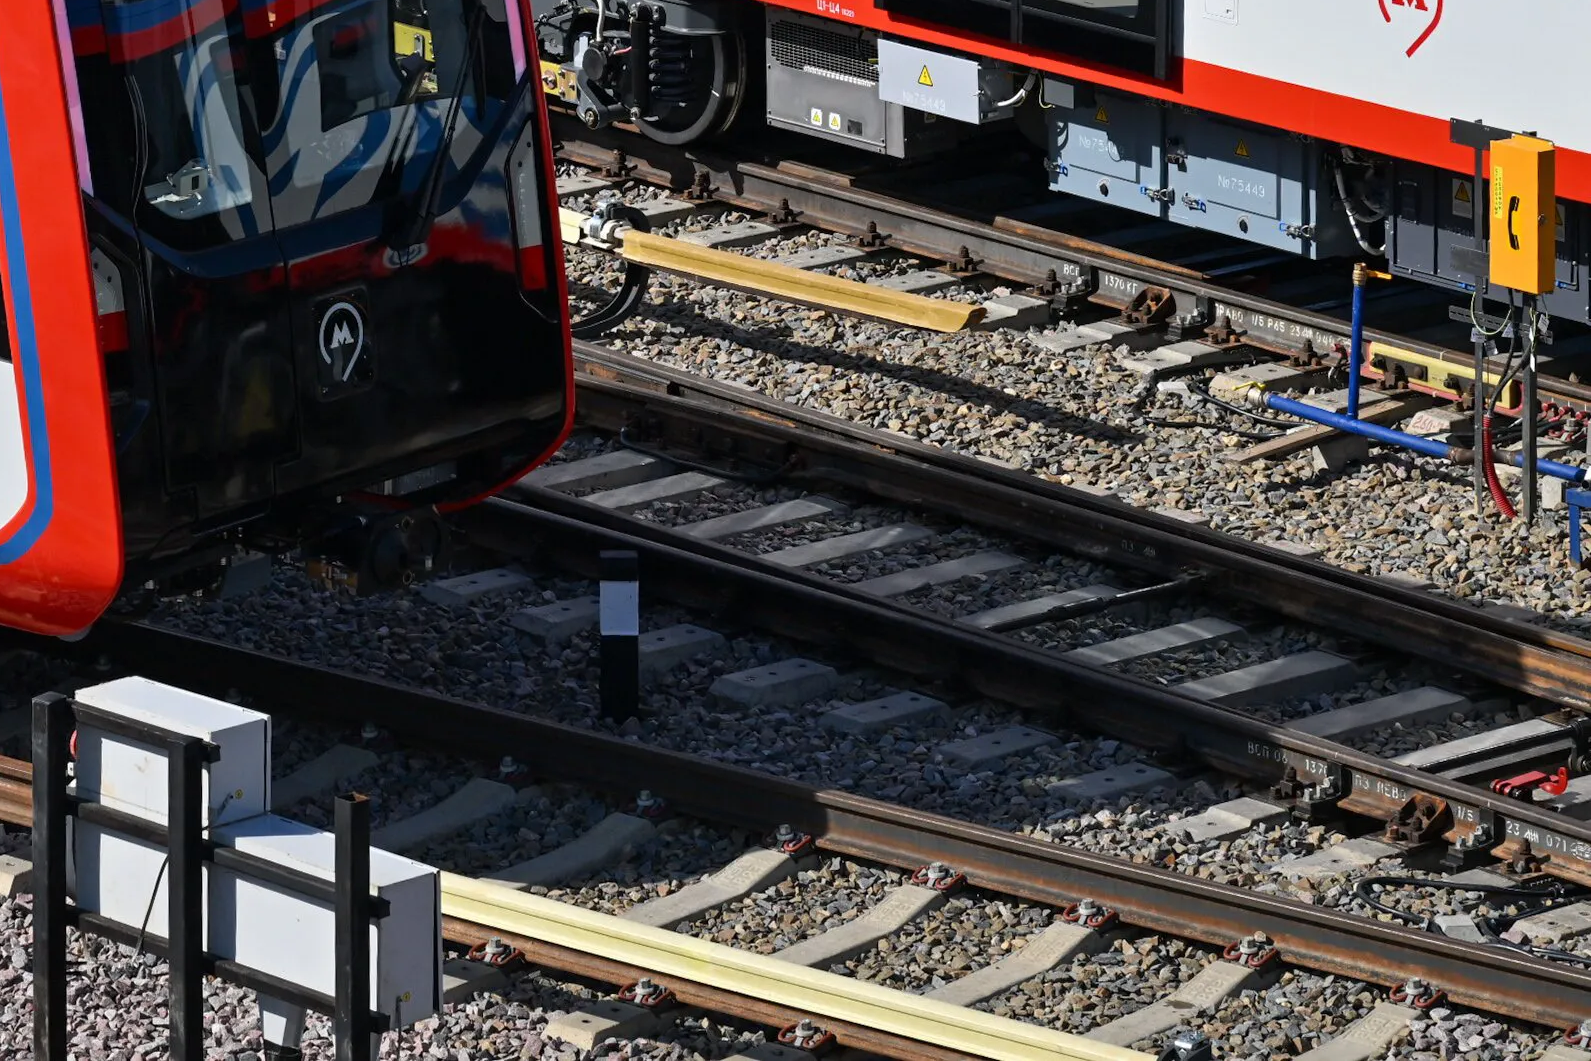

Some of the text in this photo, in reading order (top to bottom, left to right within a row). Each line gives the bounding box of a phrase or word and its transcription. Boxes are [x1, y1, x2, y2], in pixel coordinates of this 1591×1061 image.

[1216, 174, 1266, 199] №75449
[1105, 273, 1138, 295] 1370 КГ
[1251, 314, 1264, 328] 1/5
[1267, 320, 1285, 333] Р65
[1457, 805, 1474, 822] 1/5
[1506, 820, 1520, 836] 23
[1545, 834, 1567, 852] 071
